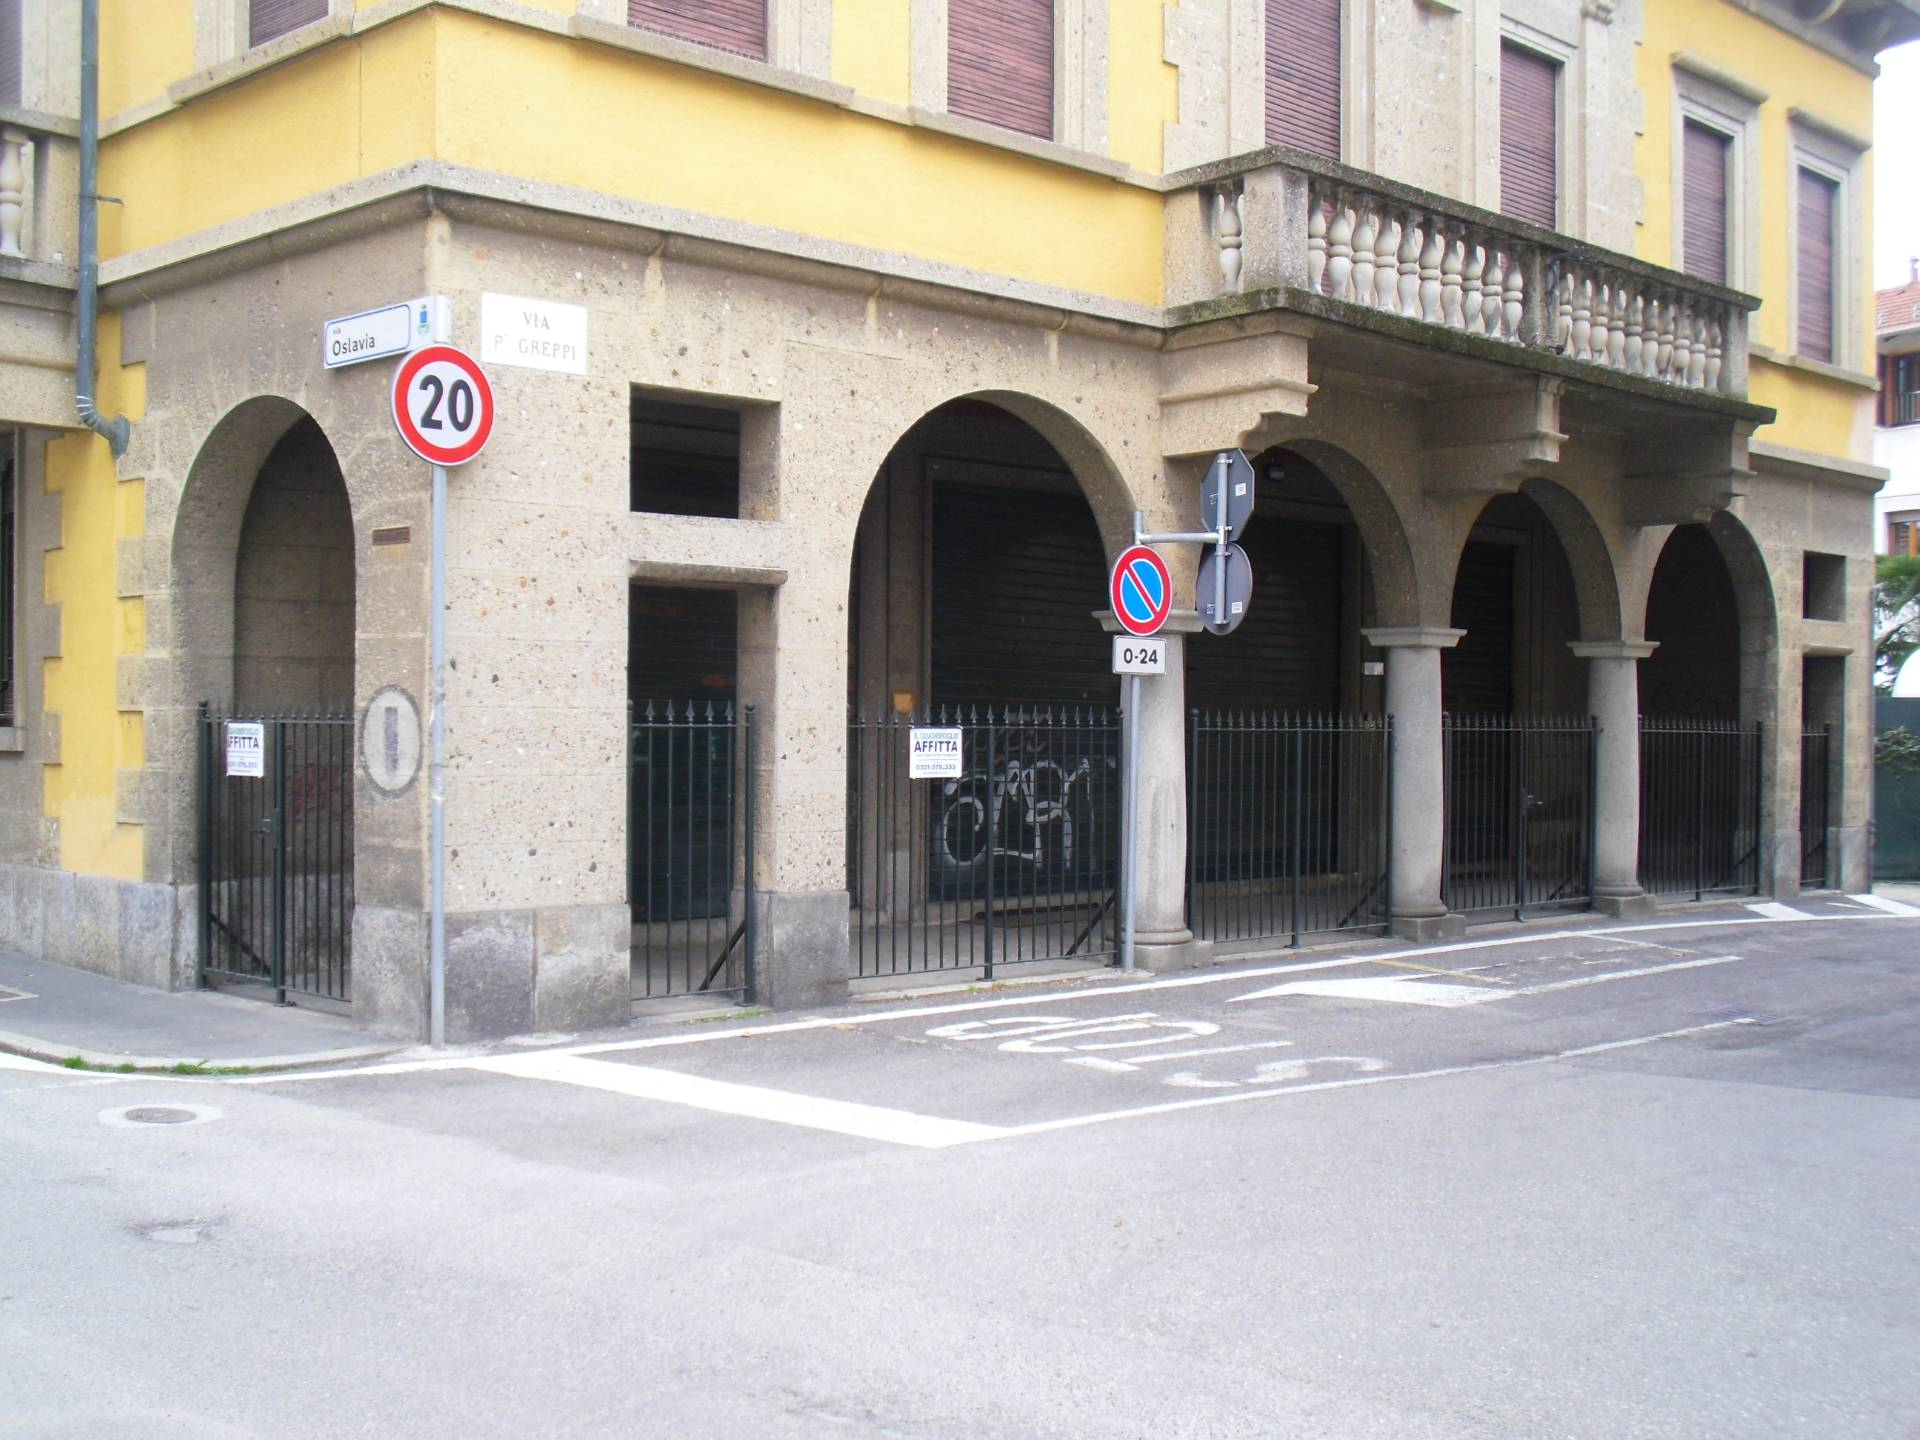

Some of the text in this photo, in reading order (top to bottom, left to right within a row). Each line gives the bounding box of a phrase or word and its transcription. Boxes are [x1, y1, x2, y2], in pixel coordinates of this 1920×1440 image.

[523, 311, 550, 330] VIA
[332, 332, 375, 356] Oslavia
[518, 338, 576, 361] GREPPI
[419, 374, 474, 432] 20
[1123, 648, 1158, 665] 0-24
[913, 740, 958, 753] AFFITTA
